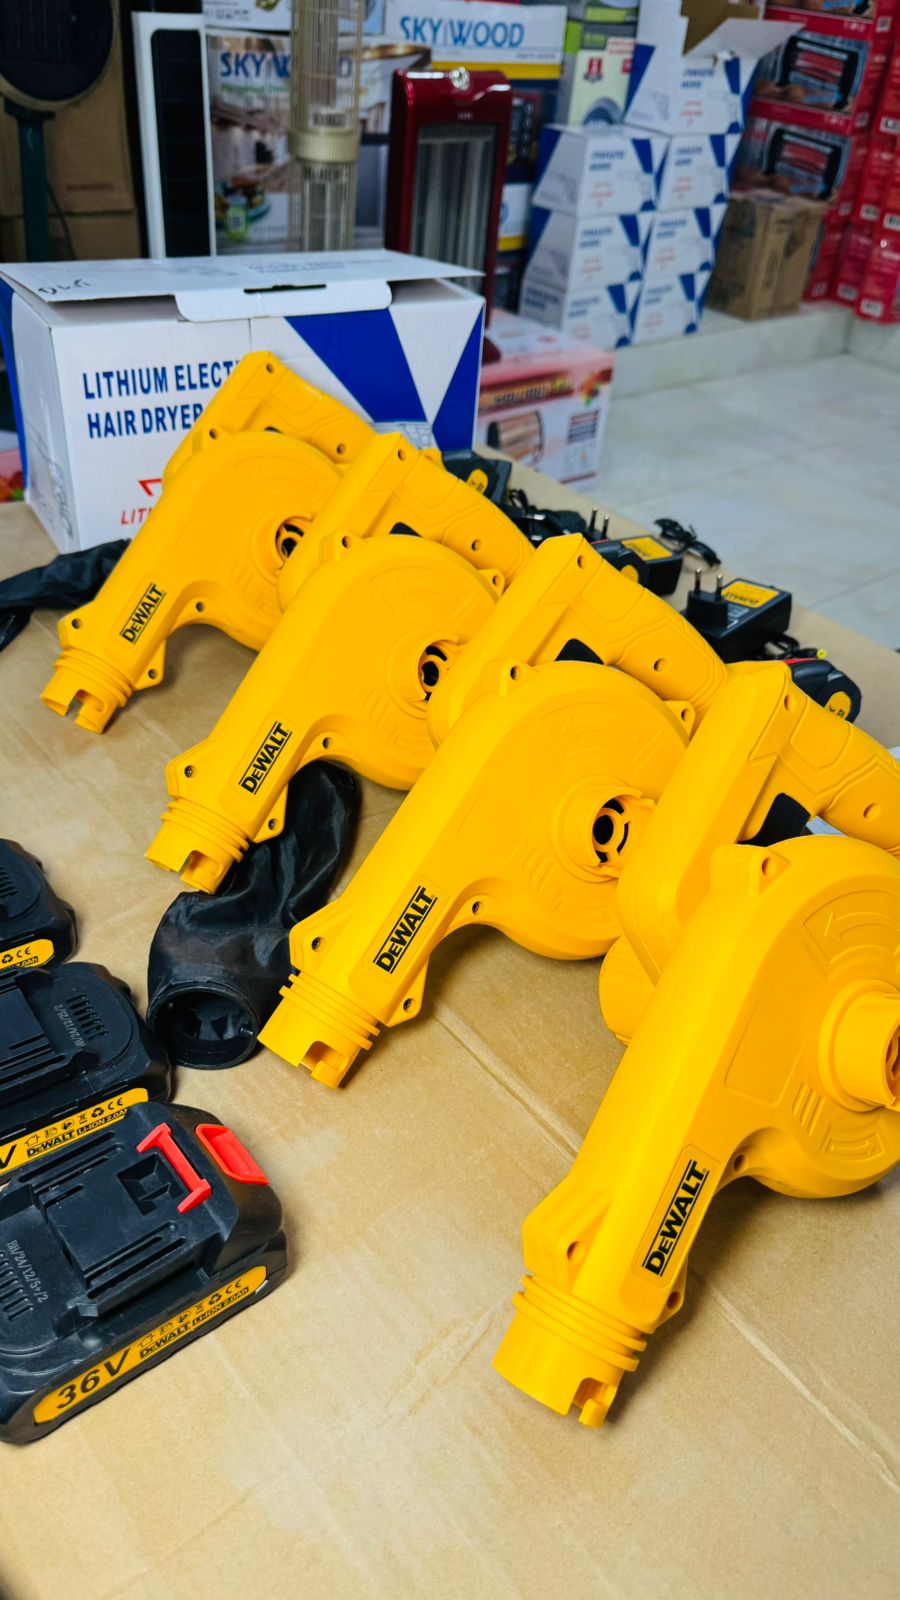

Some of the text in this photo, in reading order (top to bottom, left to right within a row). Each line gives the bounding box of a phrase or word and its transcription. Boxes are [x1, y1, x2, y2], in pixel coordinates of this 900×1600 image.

[82, 359, 240, 400] LITHIUM ELECT
[87, 410, 138, 440] HAIR
[121, 583, 163, 644] DEWALT
[240, 722, 289, 794] DEWALT
[375, 886, 434, 973] DEWALT
[26, 1130, 77, 1158] DEWALT
[644, 1160, 705, 1275] DEWALT
[56, 1347, 132, 1409] 36V
